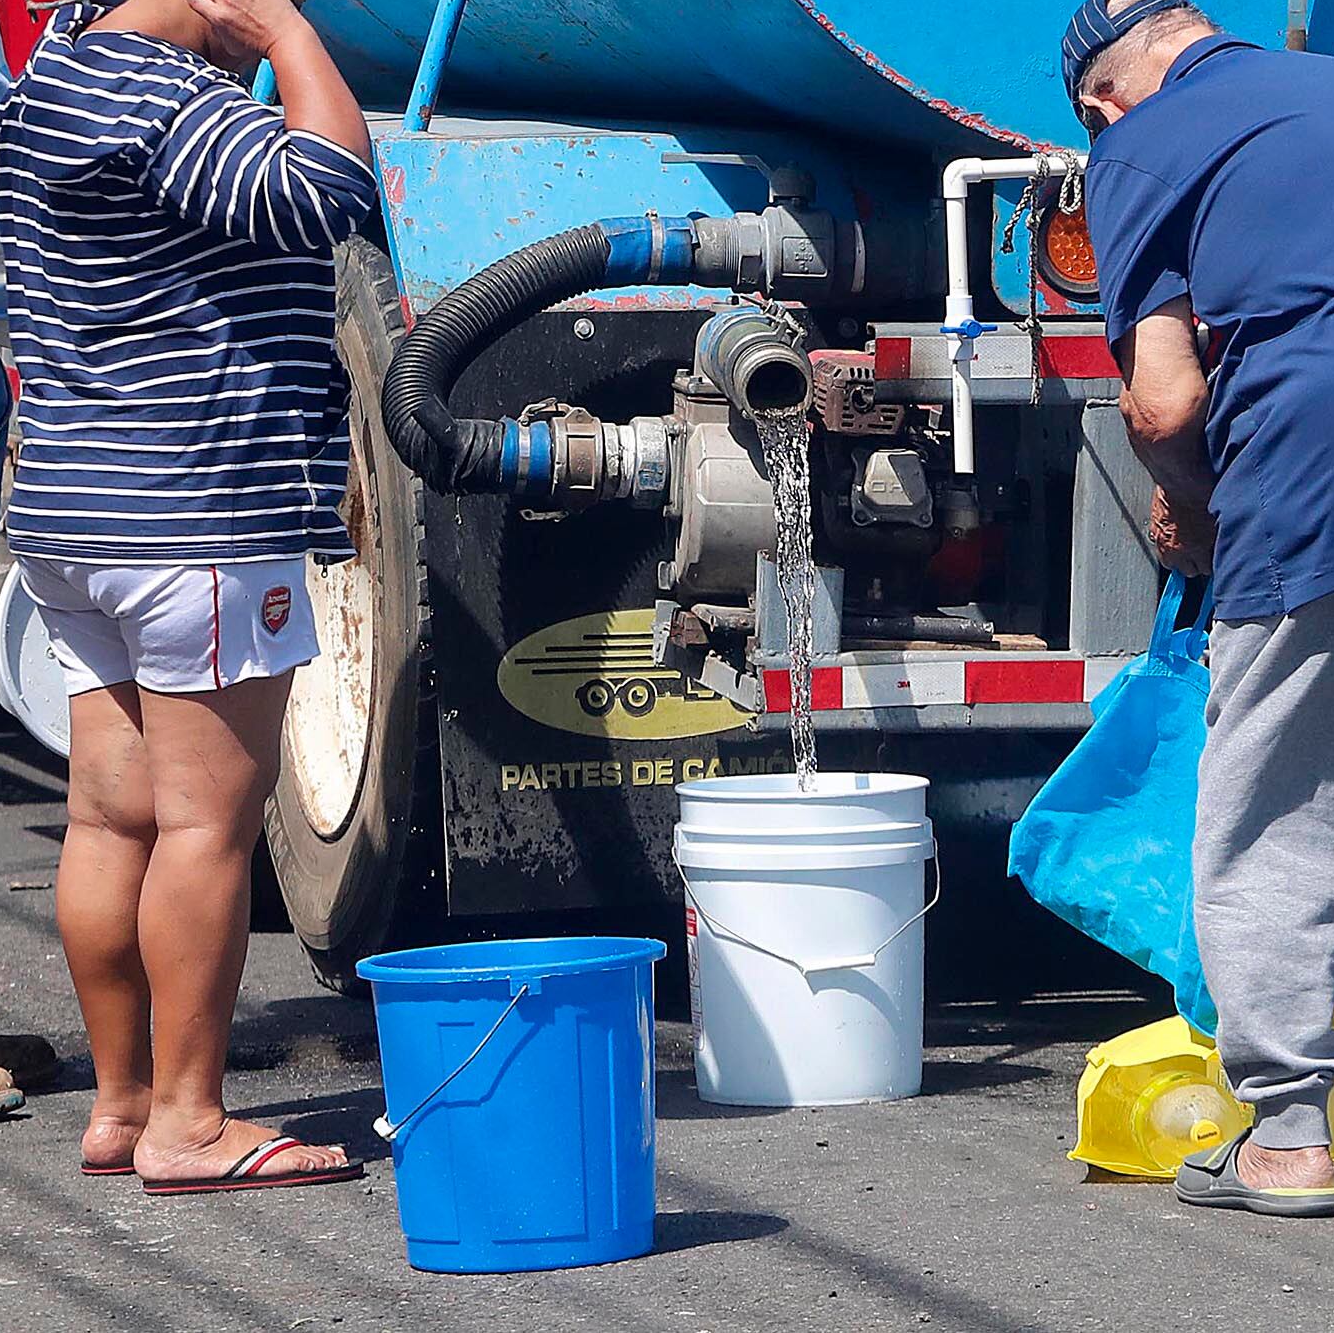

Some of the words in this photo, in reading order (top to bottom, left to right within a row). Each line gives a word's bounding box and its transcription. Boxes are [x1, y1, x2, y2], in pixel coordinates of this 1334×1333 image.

[897, 679, 911, 688] 3M
[501, 761, 623, 791] PARTES
[631, 758, 674, 786] DE
[682, 750, 797, 783] CAMIÓ
